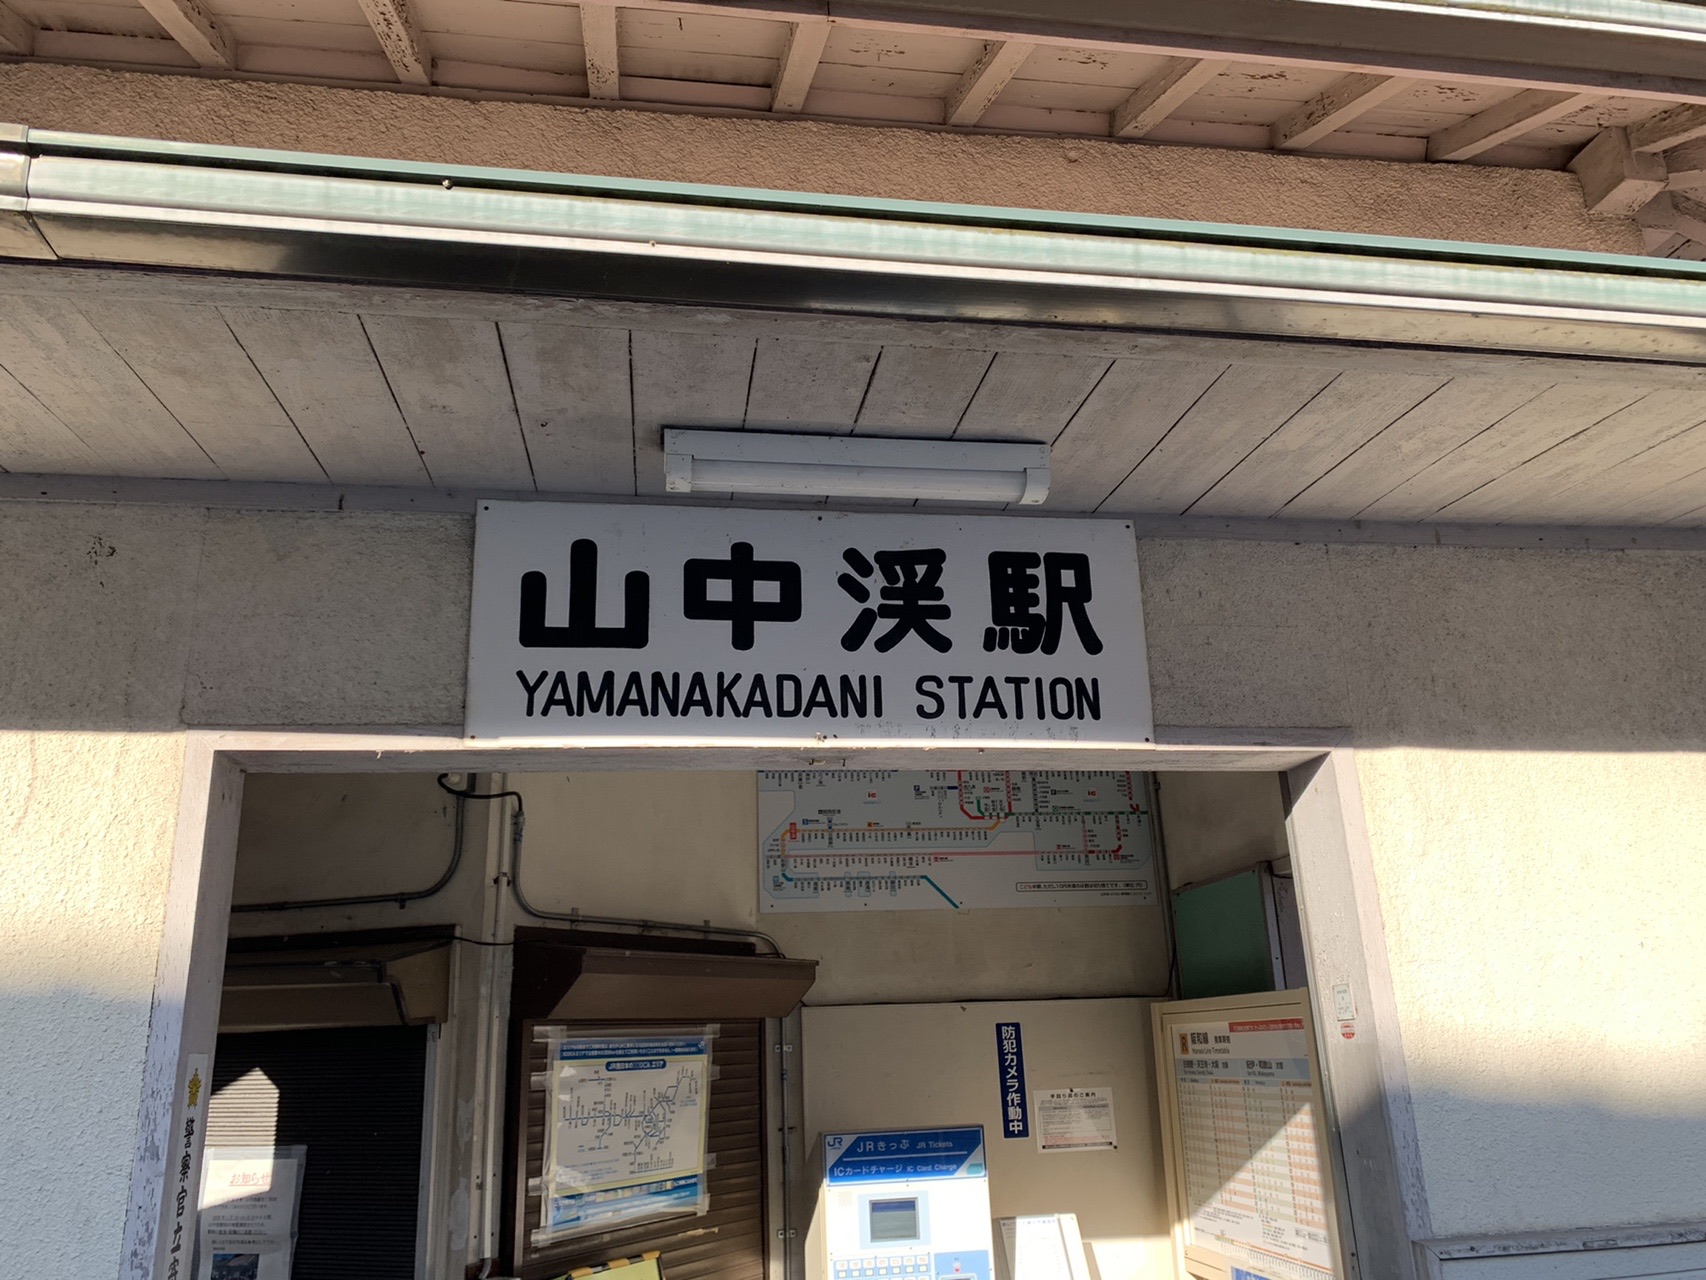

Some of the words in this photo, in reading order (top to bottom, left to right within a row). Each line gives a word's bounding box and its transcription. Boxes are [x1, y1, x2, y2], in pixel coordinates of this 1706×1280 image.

[518, 538, 1104, 656] 山中渓駅
[516, 670, 884, 719] YAMANAKADANI
[915, 675, 1102, 722] STATION
[1001, 1025, 1023, 1135] 防犯カメラ作動中
[928, 1140, 953, 1149] Tickets
[230, 1172, 271, 1184] お知らせ
[833, 1164, 903, 1177] ICカードチャージ
